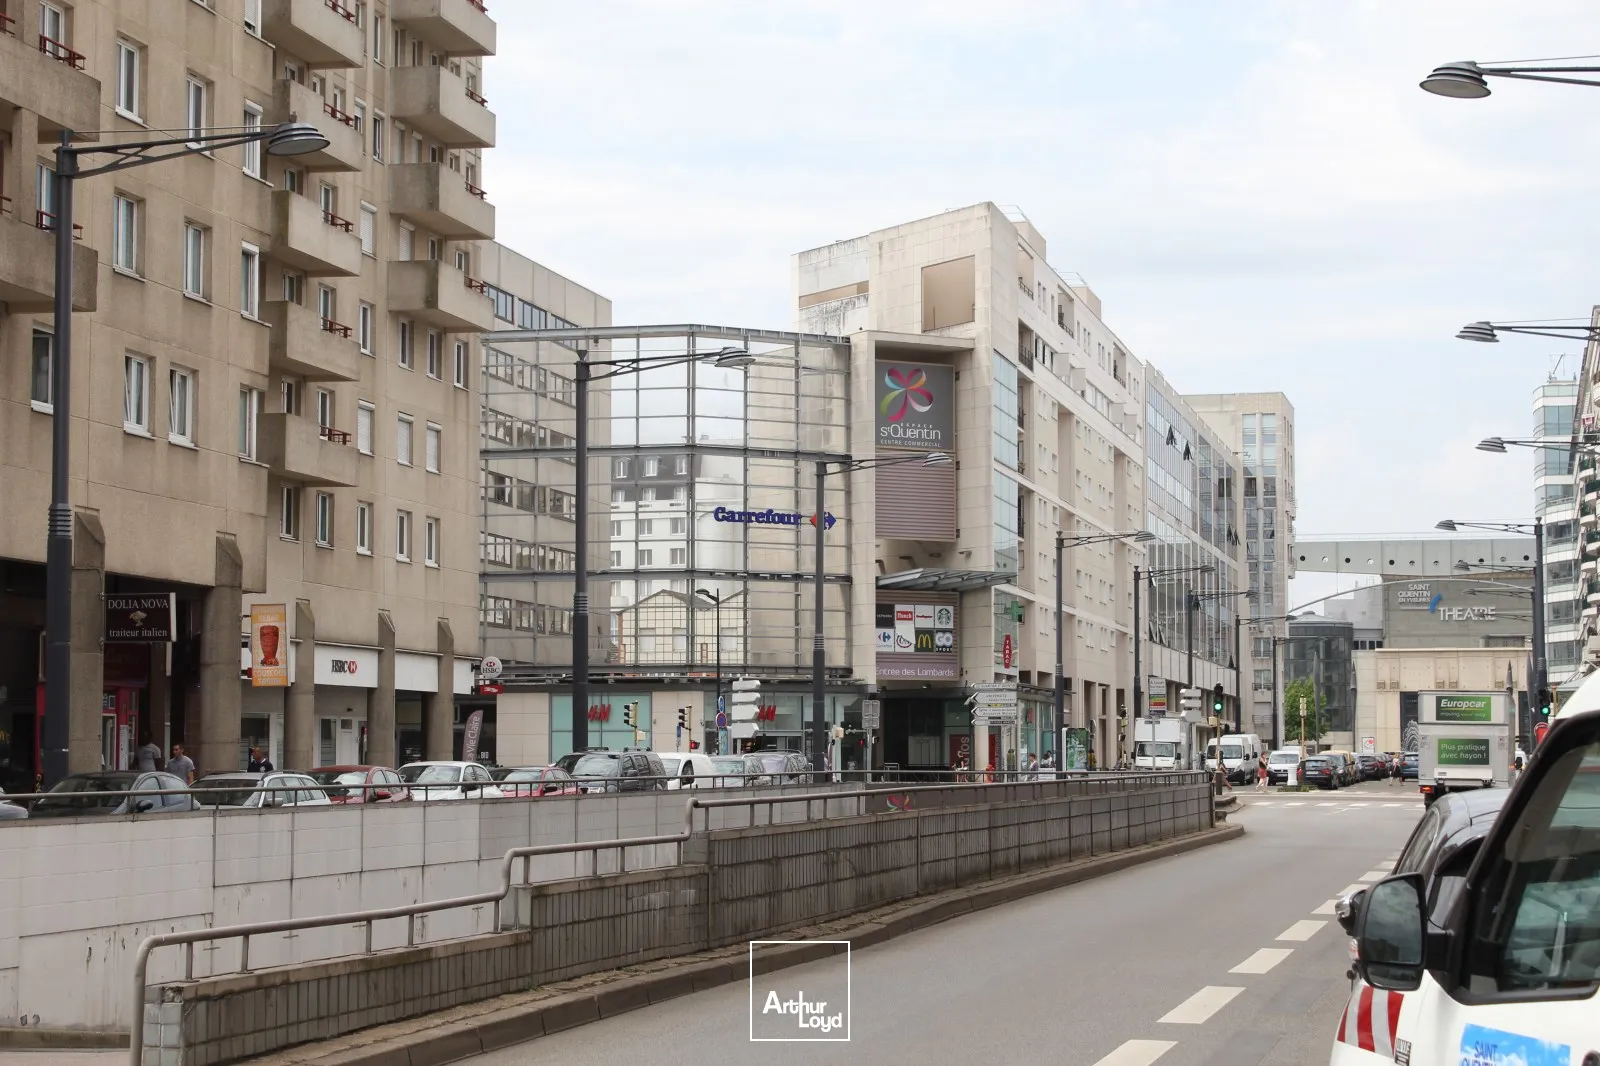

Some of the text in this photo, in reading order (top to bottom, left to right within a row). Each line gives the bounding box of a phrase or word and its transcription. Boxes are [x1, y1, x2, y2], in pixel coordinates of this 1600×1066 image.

[904, 440, 941, 448] COMMERCIAL
[713, 506, 802, 526] Carrefour
[1408, 583, 1431, 591] SAINT
[1397, 590, 1431, 598] QUENTIN
[108, 598, 169, 609] DOLIA NOVA
[109, 627, 168, 637] traiteur italien
[331, 659, 348, 673] HSBC
[901, 667, 916, 676] des
[917, 667, 954, 677] Lombards
[1440, 699, 1487, 710] Europcar
[468, 716, 481, 739] Claire
[466, 739, 476, 753] Vie
[1441, 743, 1487, 753] Plus pratique
[1459, 752, 1482, 760] hayon
[1474, 1040, 1498, 1062] SAINT
